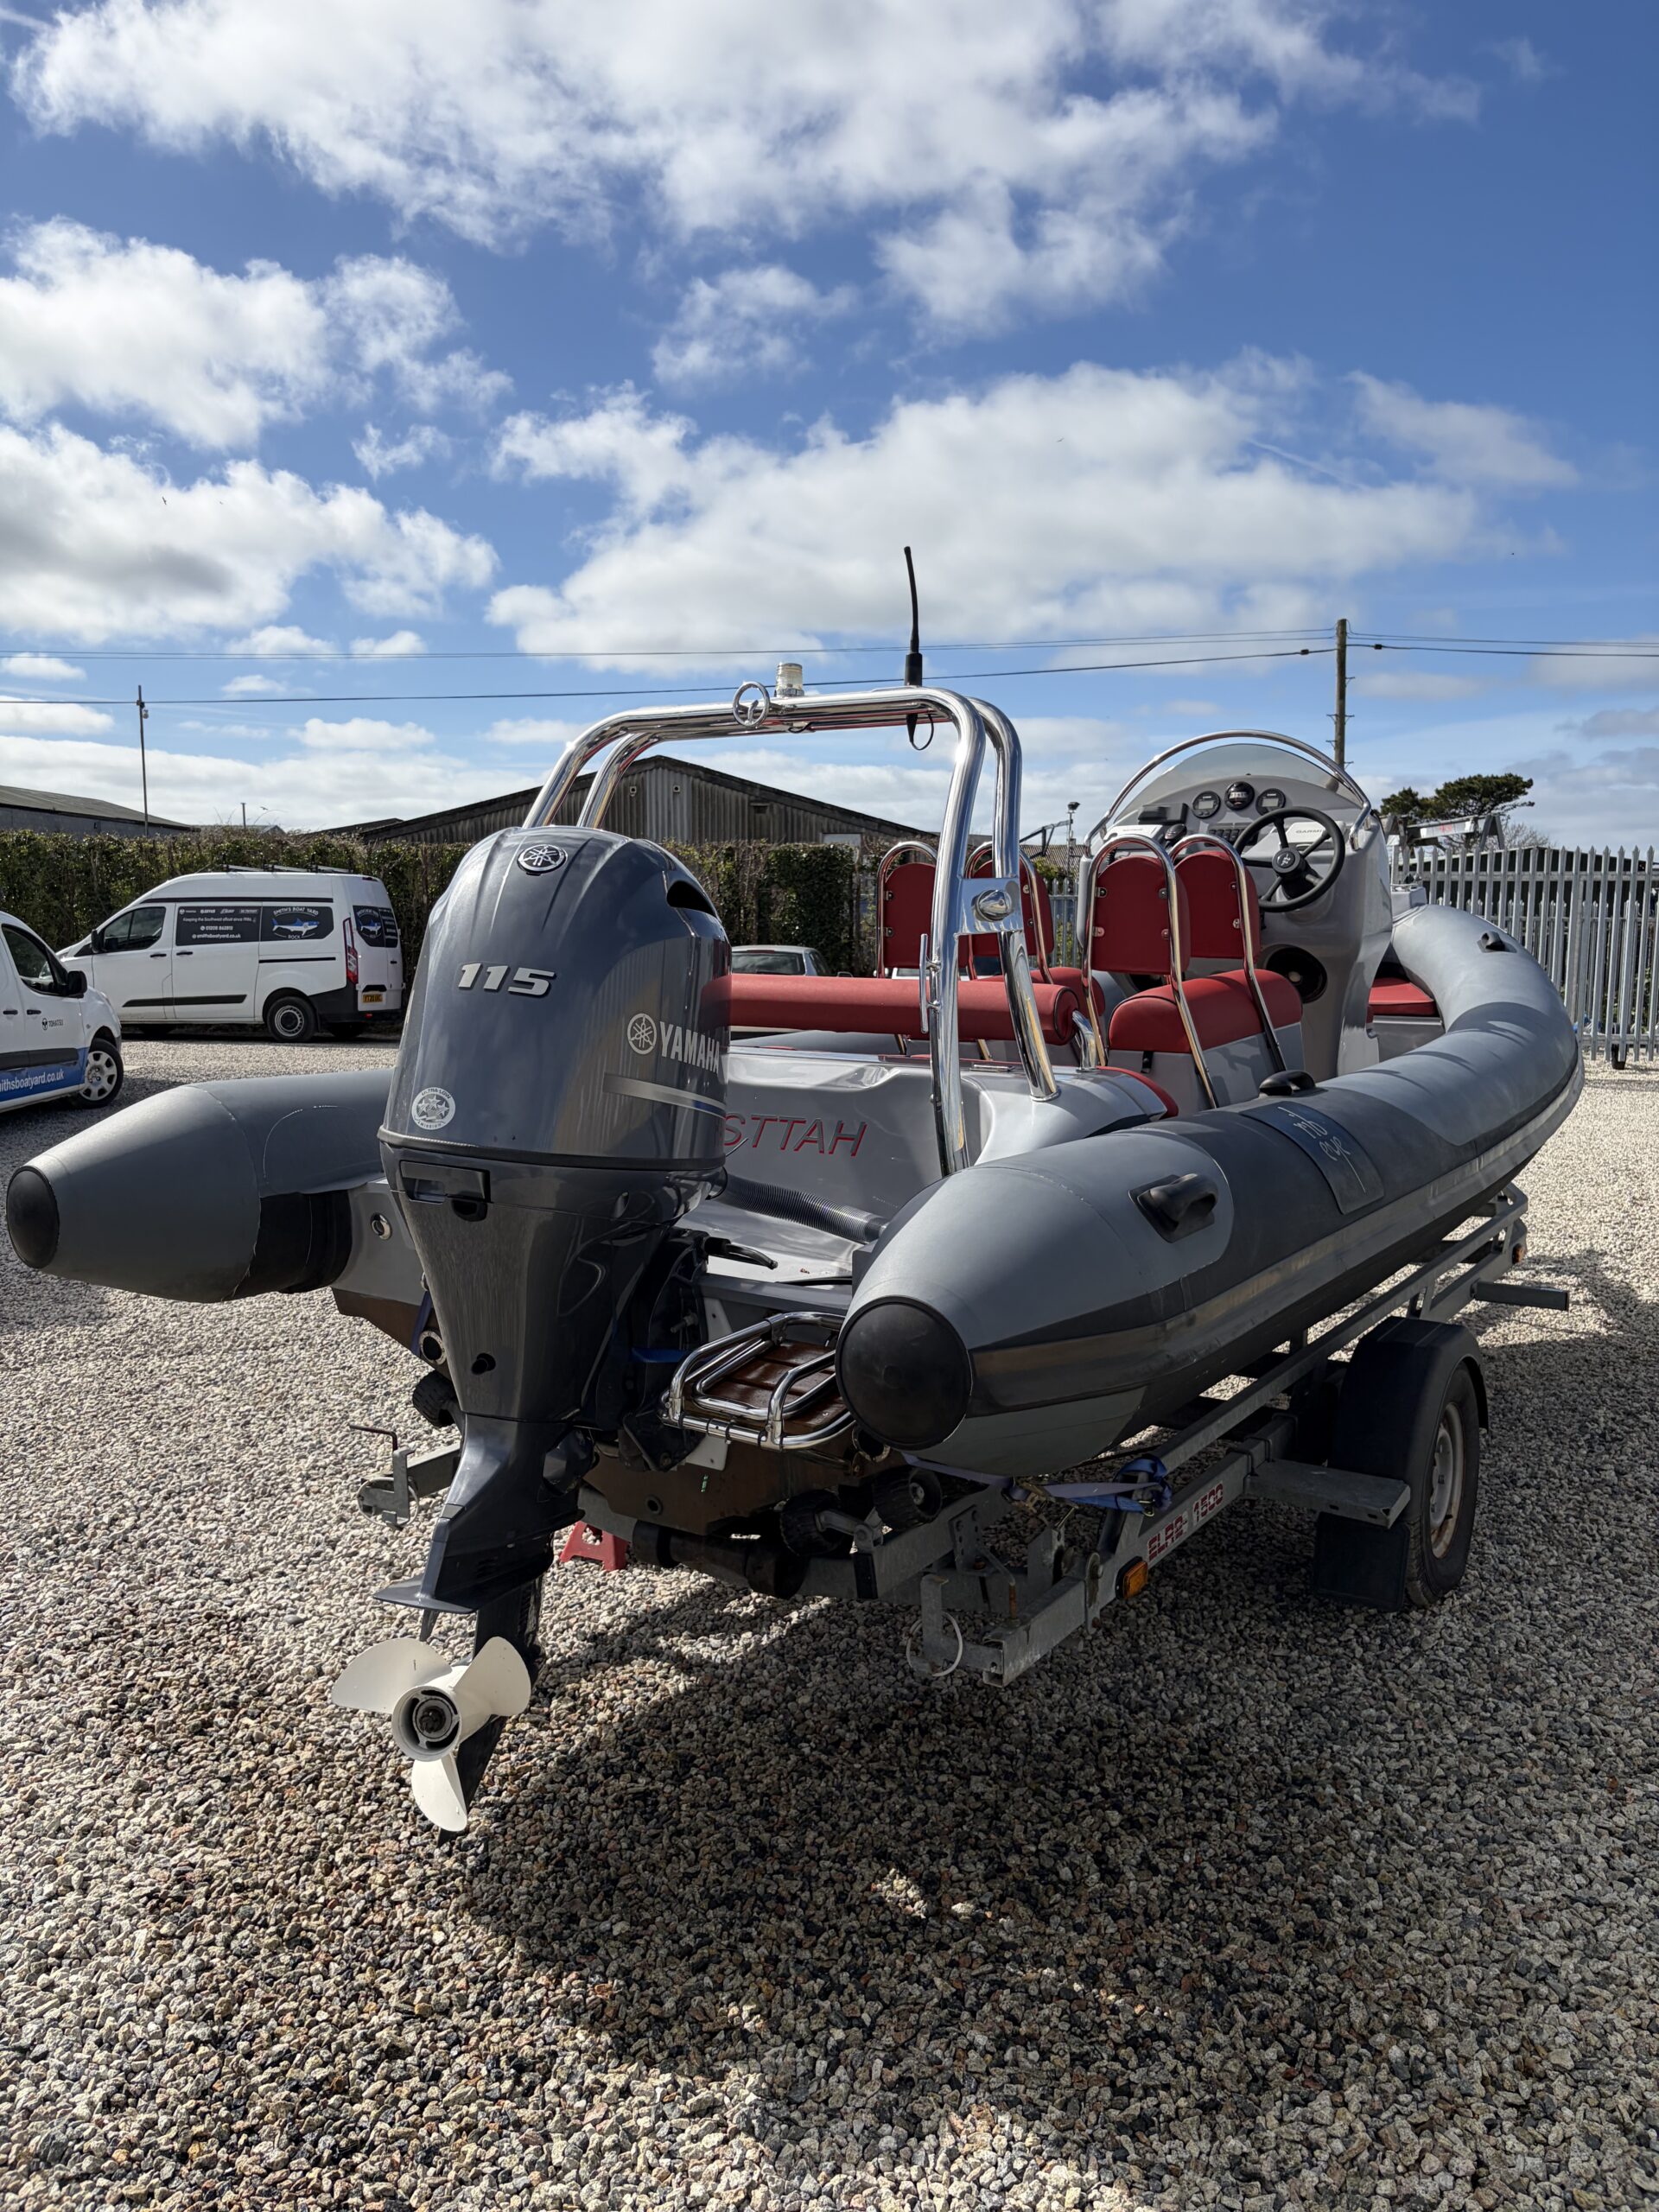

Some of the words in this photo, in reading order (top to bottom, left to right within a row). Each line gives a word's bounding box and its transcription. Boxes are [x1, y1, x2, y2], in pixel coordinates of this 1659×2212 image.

[458, 963, 556, 996] 115
[48, 1019, 64, 1027] TOHATSU
[659, 1020, 721, 1075] YAMAHA
[1192, 1483, 1224, 1522] 1500
